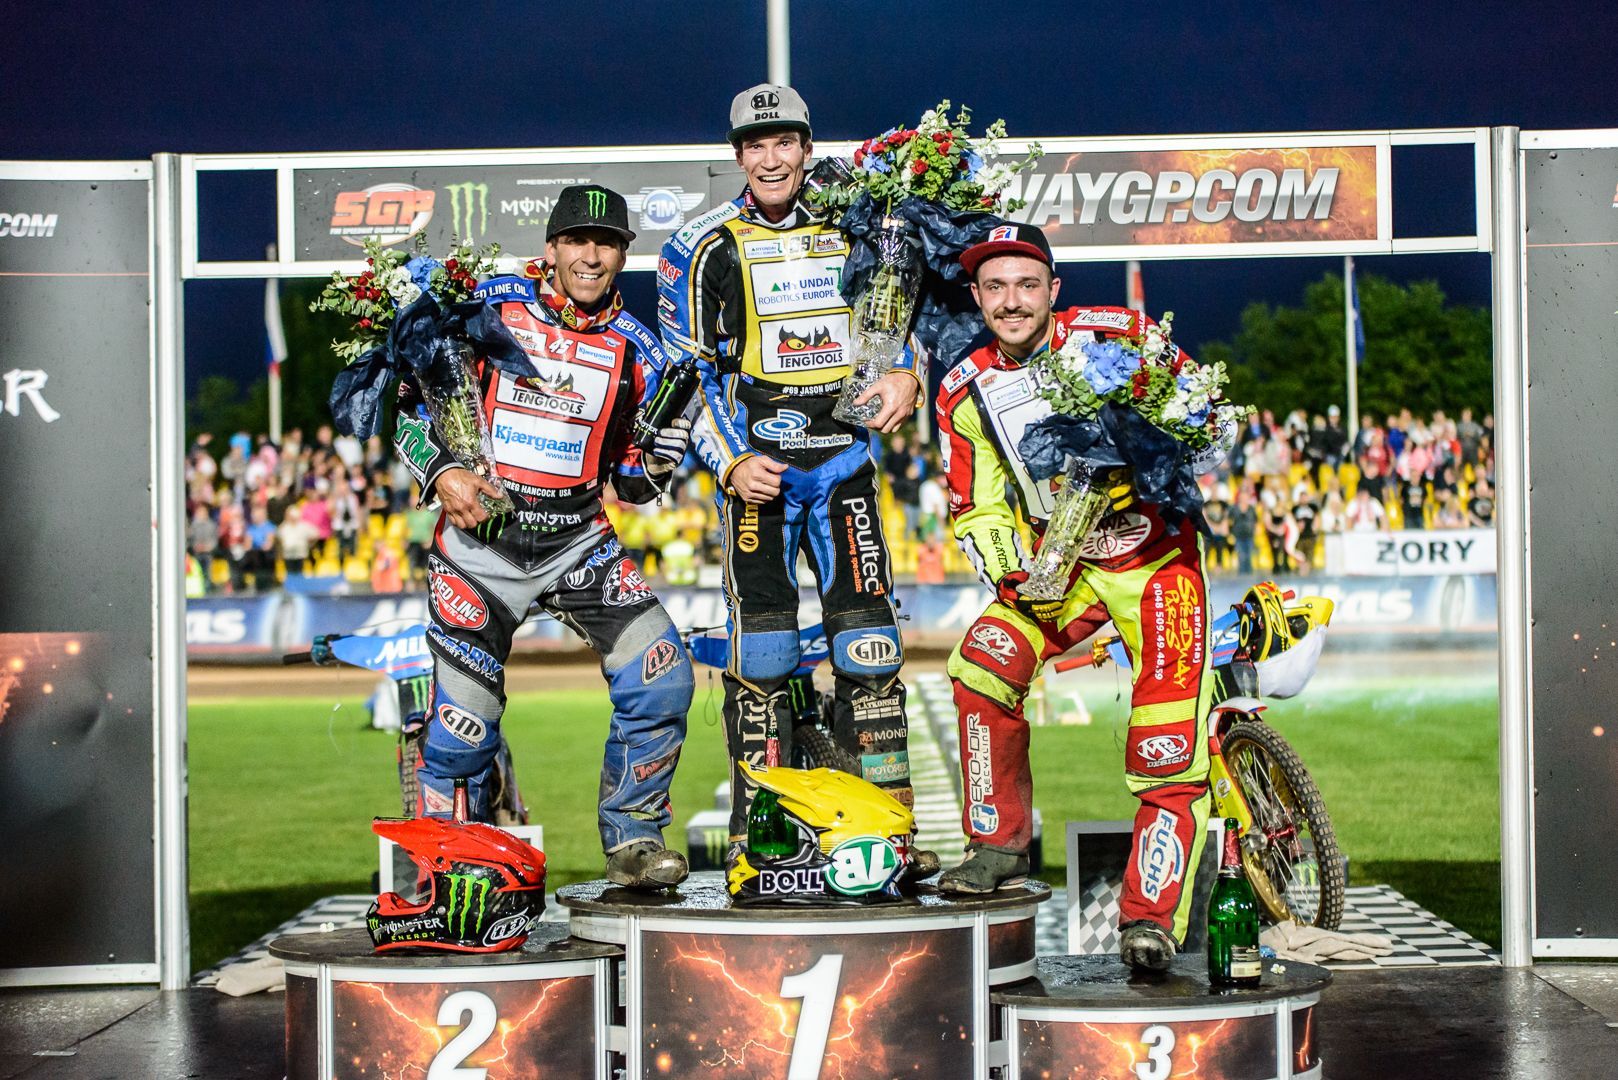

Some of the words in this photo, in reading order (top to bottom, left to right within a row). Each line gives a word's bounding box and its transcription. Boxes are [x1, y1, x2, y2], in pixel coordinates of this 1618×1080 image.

[754, 111, 780, 121] BOLL
[331, 190, 435, 226] SGP
[648, 202, 676, 217] FIM
[489, 283, 512, 297] LINE
[514, 282, 530, 297] OIL
[783, 277, 834, 291] HYUNDAI
[758, 294, 800, 305] ROBOTICS
[802, 289, 835, 300] EUROPE
[1069, 309, 1133, 331] Zengineering
[549, 338, 574, 354] 45
[614, 317, 633, 333] RED
[636, 328, 655, 349] LINE
[650, 346, 666, 366] OIL
[778, 349, 843, 369] TENGTOOLS
[800, 385, 824, 396] JASON
[825, 381, 842, 393] DOYLE
[512, 389, 585, 415] TENGTOOLS
[495, 424, 583, 454] Kjærgaard
[782, 440, 806, 448] Pool
[810, 436, 851, 447] Services
[521, 484, 556, 498] HANCOCK
[559, 488, 572, 497] USA
[843, 497, 880, 593] poultec
[848, 528, 857, 555] training
[852, 556, 862, 593] specialists
[434, 576, 454, 601] RED
[449, 594, 484, 623] LINE
[1153, 583, 1164, 608] 0048
[854, 640, 892, 661] GM
[442, 706, 484, 738] GM
[968, 714, 983, 803] EKO-DIR
[1146, 753, 1190, 769] DESIGN
[1145, 813, 1174, 898] FUCHS
[759, 867, 825, 894] BOLL
[391, 931, 436, 941] ENERGY
[778, 954, 843, 1080] 1
[427, 990, 498, 1080] 2
[1135, 1026, 1177, 1080] 3
